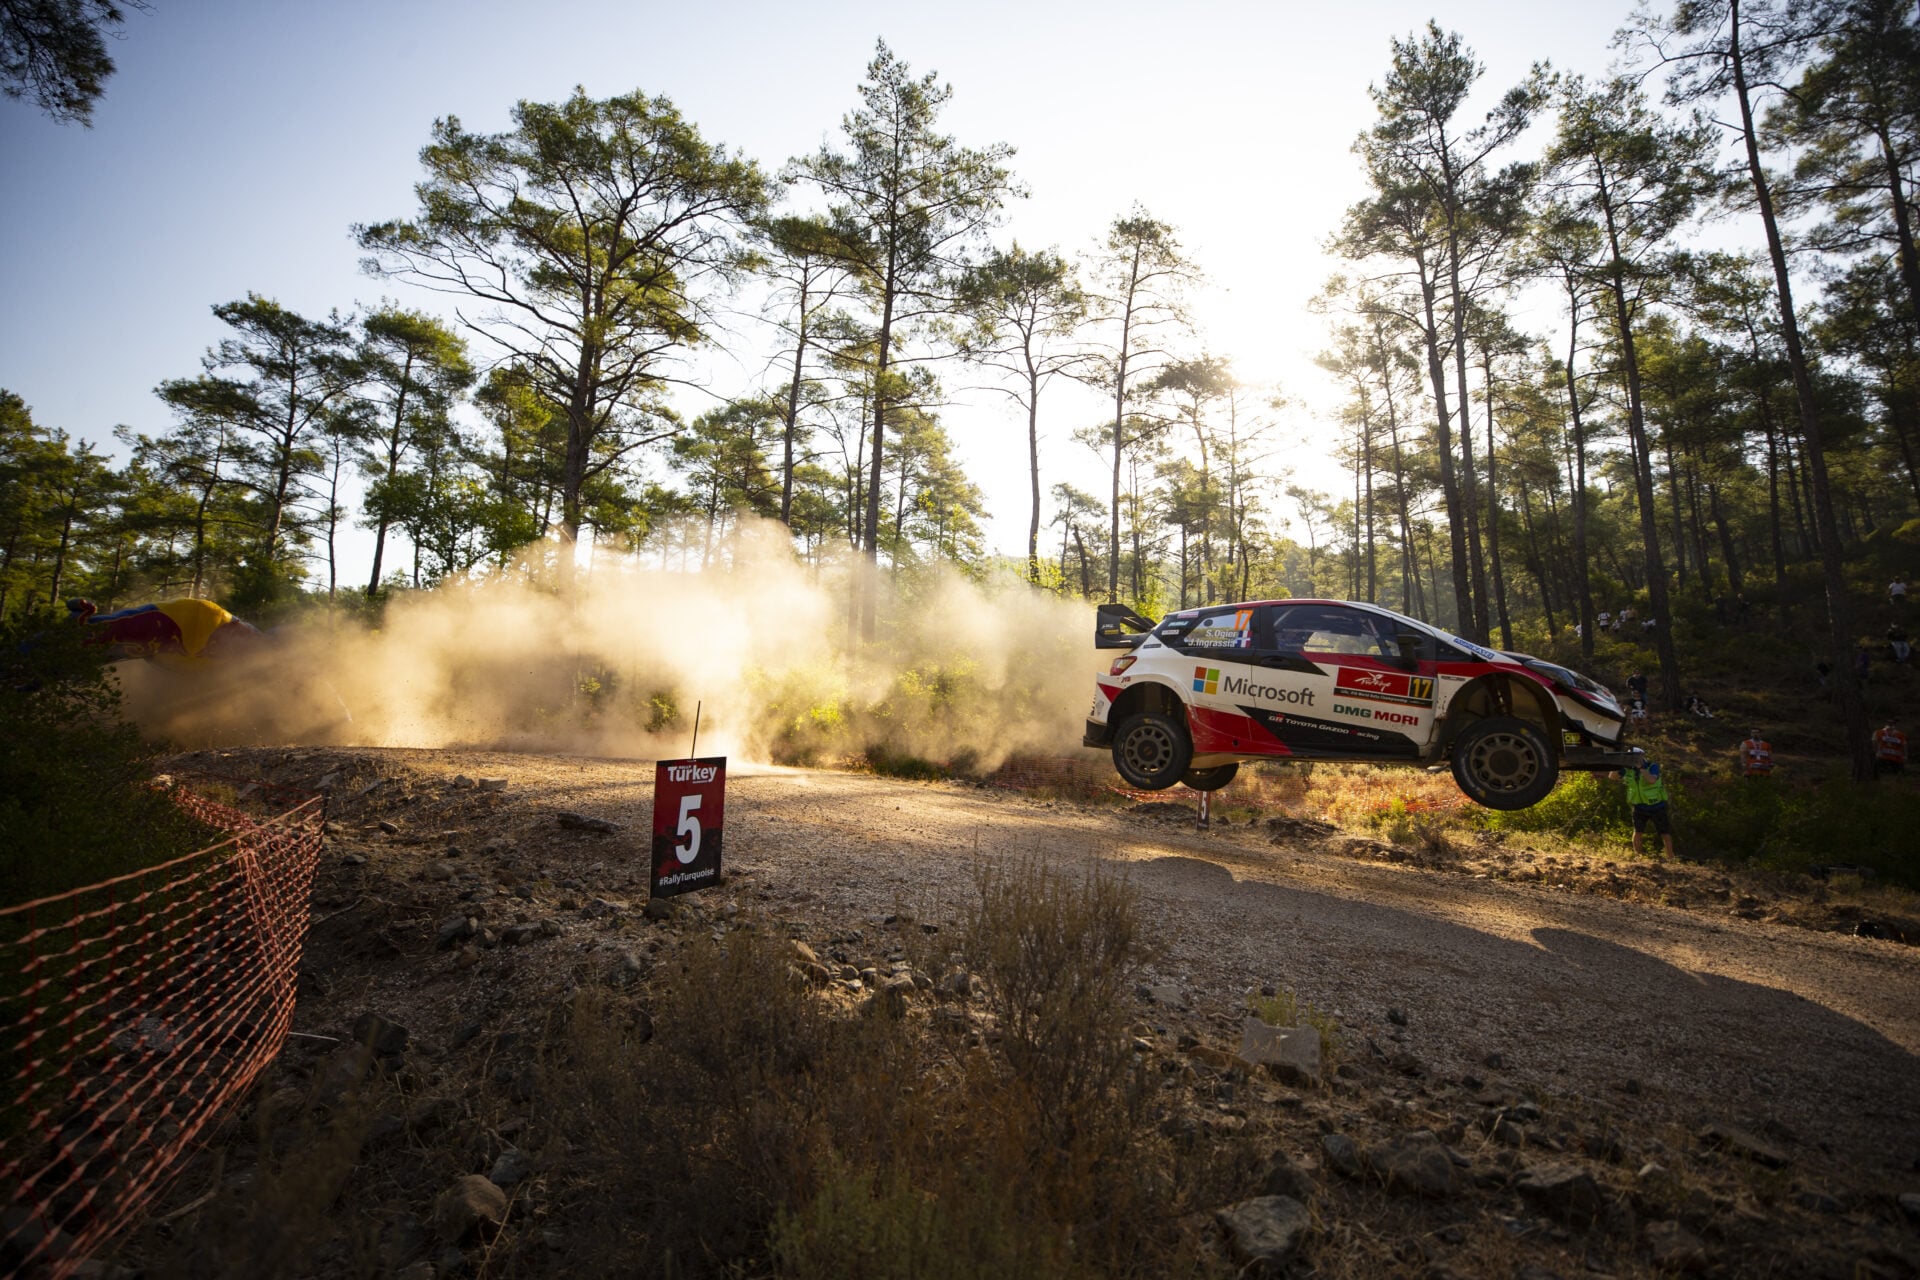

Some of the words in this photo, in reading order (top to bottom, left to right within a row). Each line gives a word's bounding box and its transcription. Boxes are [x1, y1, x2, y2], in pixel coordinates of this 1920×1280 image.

[1234, 609, 1254, 631] 17
[1188, 639, 1236, 648] J.Ingrassia
[1223, 676, 1315, 706] Microsoft
[1413, 678, 1432, 699] 17
[1285, 718, 1317, 728] TOYOTA
[1333, 704, 1372, 718] DMG
[1374, 710, 1419, 726] MORI
[667, 765, 718, 783] Turkey
[675, 794, 703, 865] 5
[659, 868, 714, 886] #RallyTurquoise
